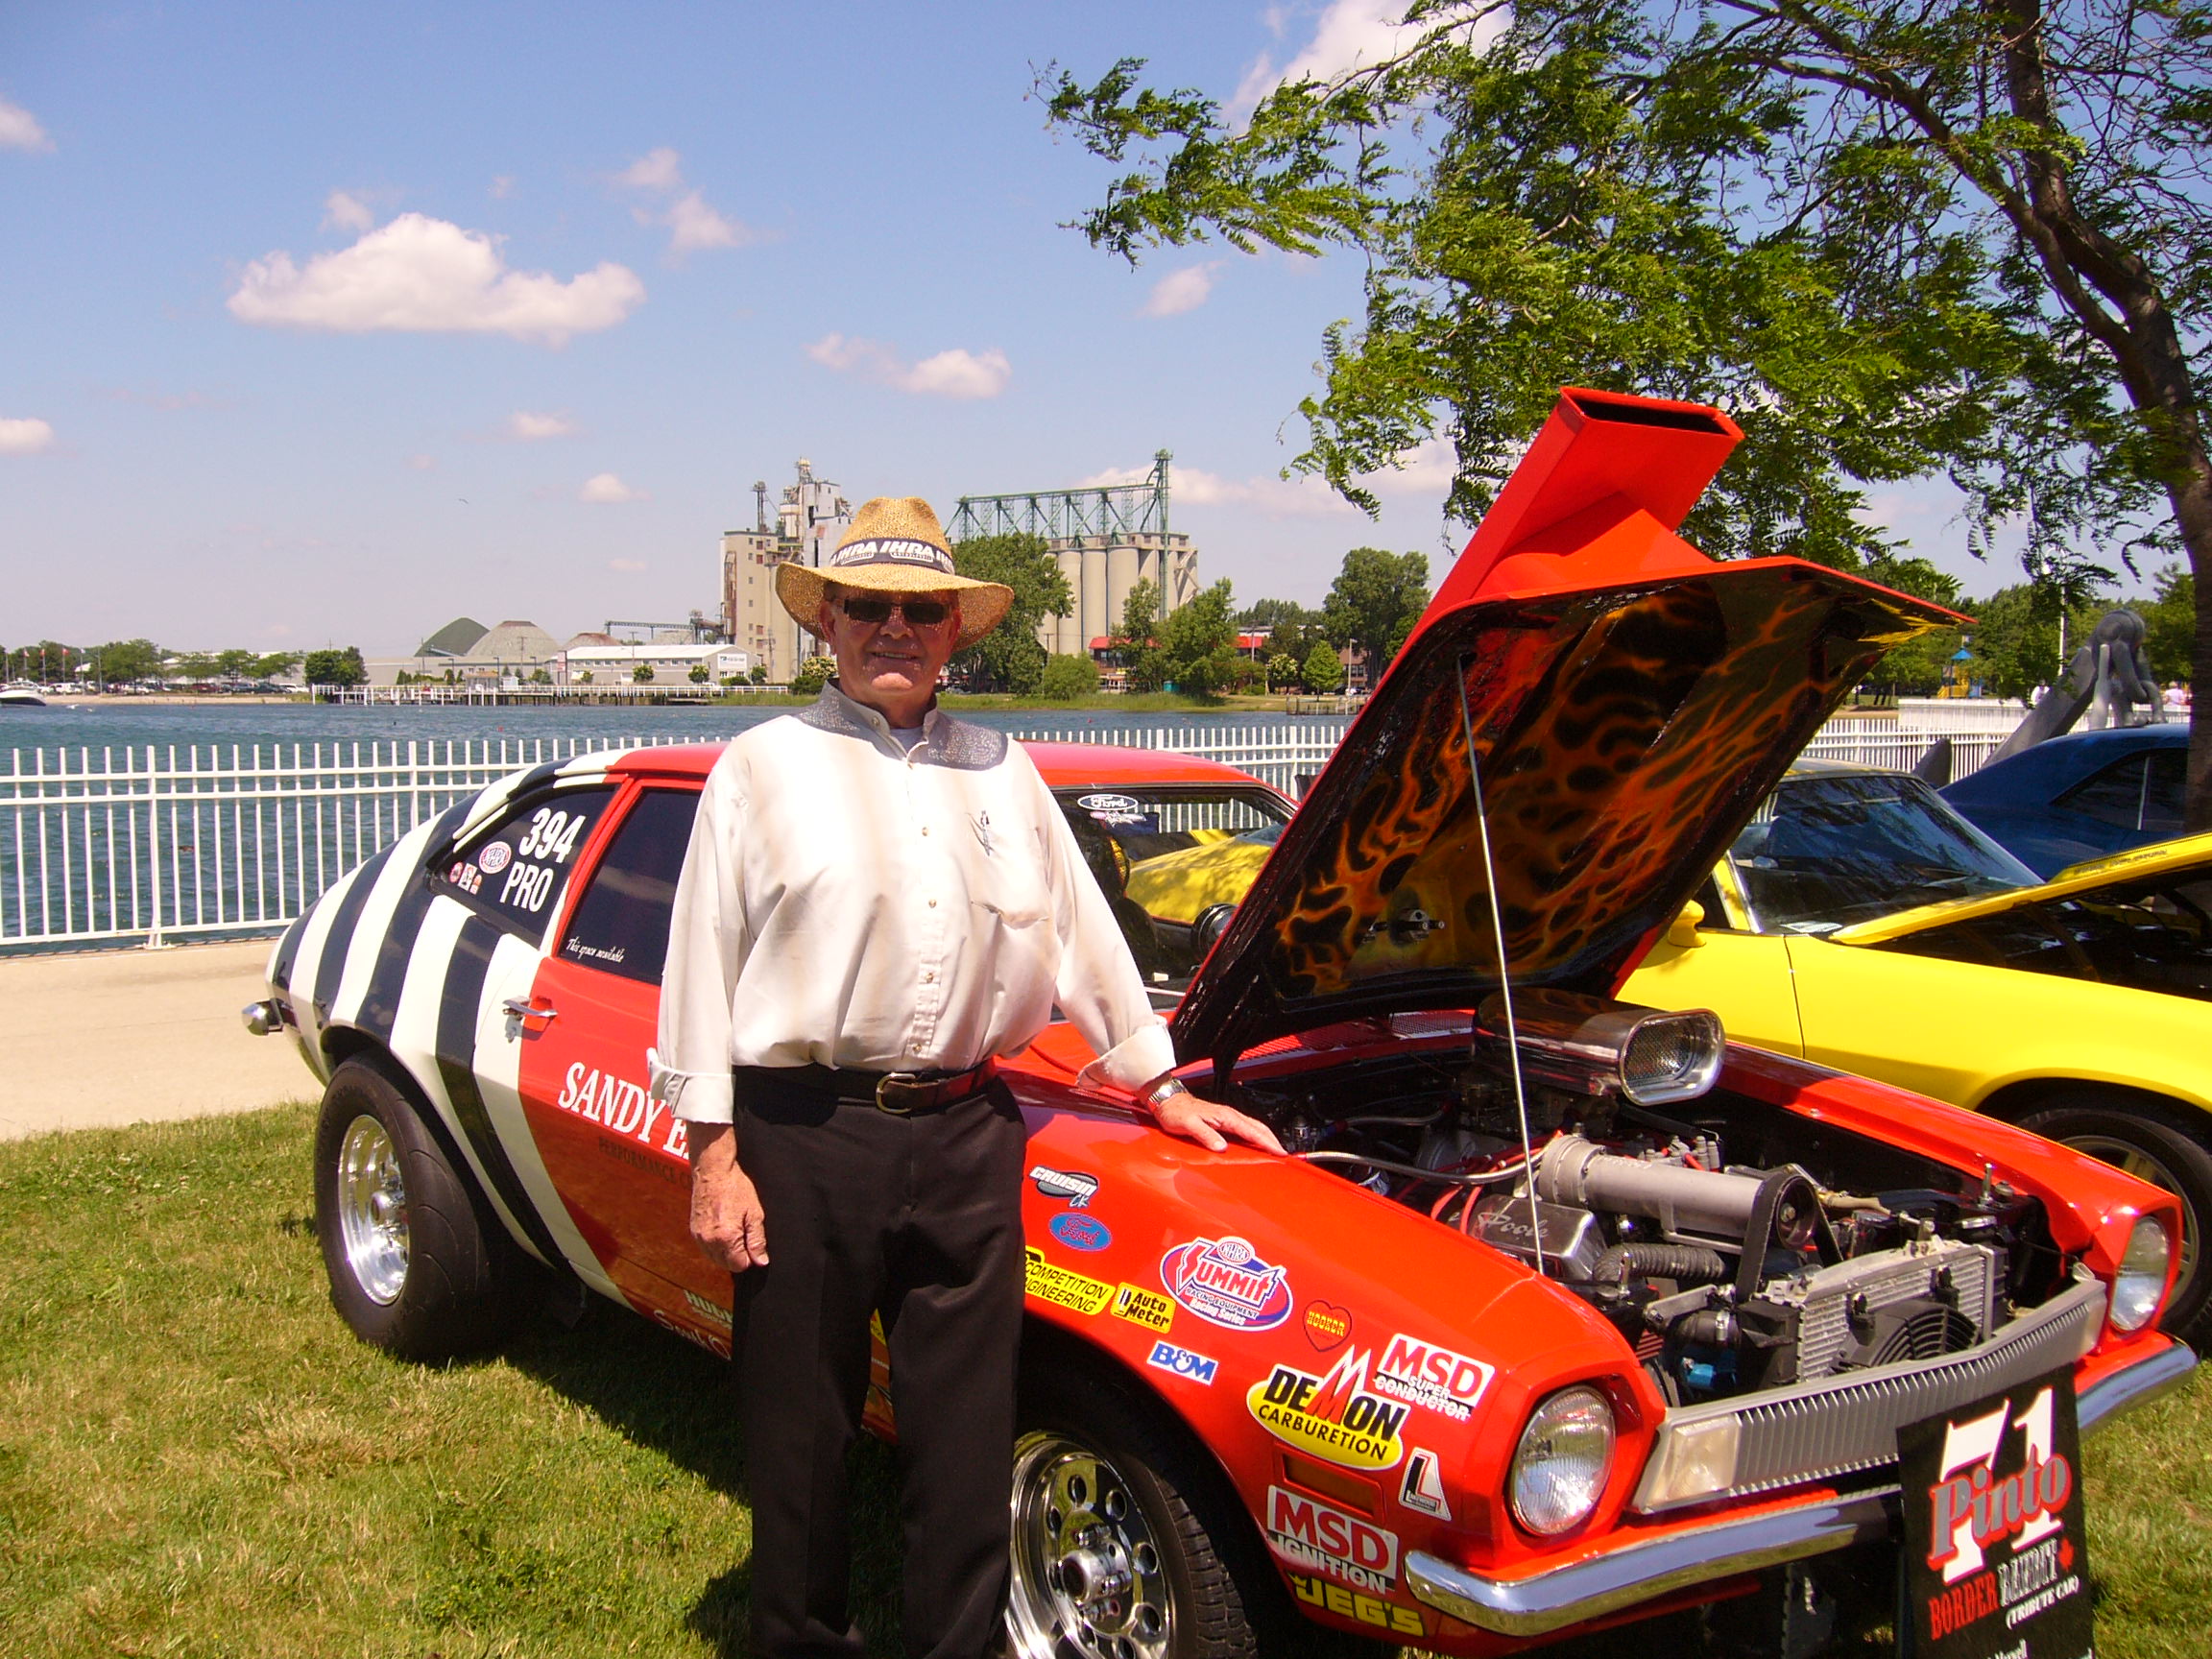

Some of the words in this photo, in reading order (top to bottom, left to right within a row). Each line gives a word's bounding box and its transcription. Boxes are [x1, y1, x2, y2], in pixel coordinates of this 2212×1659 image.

[1091, 796, 1128, 807] Ford
[519, 807, 586, 863] 394
[500, 861, 553, 913] PRO
[558, 1061, 666, 1143] SANDY
[1028, 1166, 1098, 1197] CRUISIN
[1060, 1217, 1100, 1245] Ford
[1025, 1262, 1109, 1299] COMPETITION
[1025, 1277, 1097, 1312] NGINEERING
[1133, 1292, 1166, 1312] Auto
[1186, 1287, 1214, 1304] RACING
[1214, 1297, 1259, 1319] EQUIPMENT
[1124, 1303, 1169, 1327] Meter
[1307, 1311, 1345, 1336] HOOKER
[1151, 1343, 1215, 1381] B&M
[1383, 1338, 1486, 1403] MSD
[1263, 1346, 1407, 1442] DEMON
[1373, 1375, 1471, 1421] CONDUCTOR
[1407, 1376, 1451, 1400] SUPER
[1258, 1405, 1389, 1461] CARBURETION
[1928, 1443, 2071, 1569] Pinto
[1939, 1386, 2063, 1583] 71
[1275, 1492, 1390, 1572] MSD
[1277, 1535, 1386, 1594] IGNITION
[1929, 1572, 1999, 1640] BORDER
[1998, 1537, 2057, 1607] BANDIT
[1295, 1577, 1425, 1638] JEG'S
